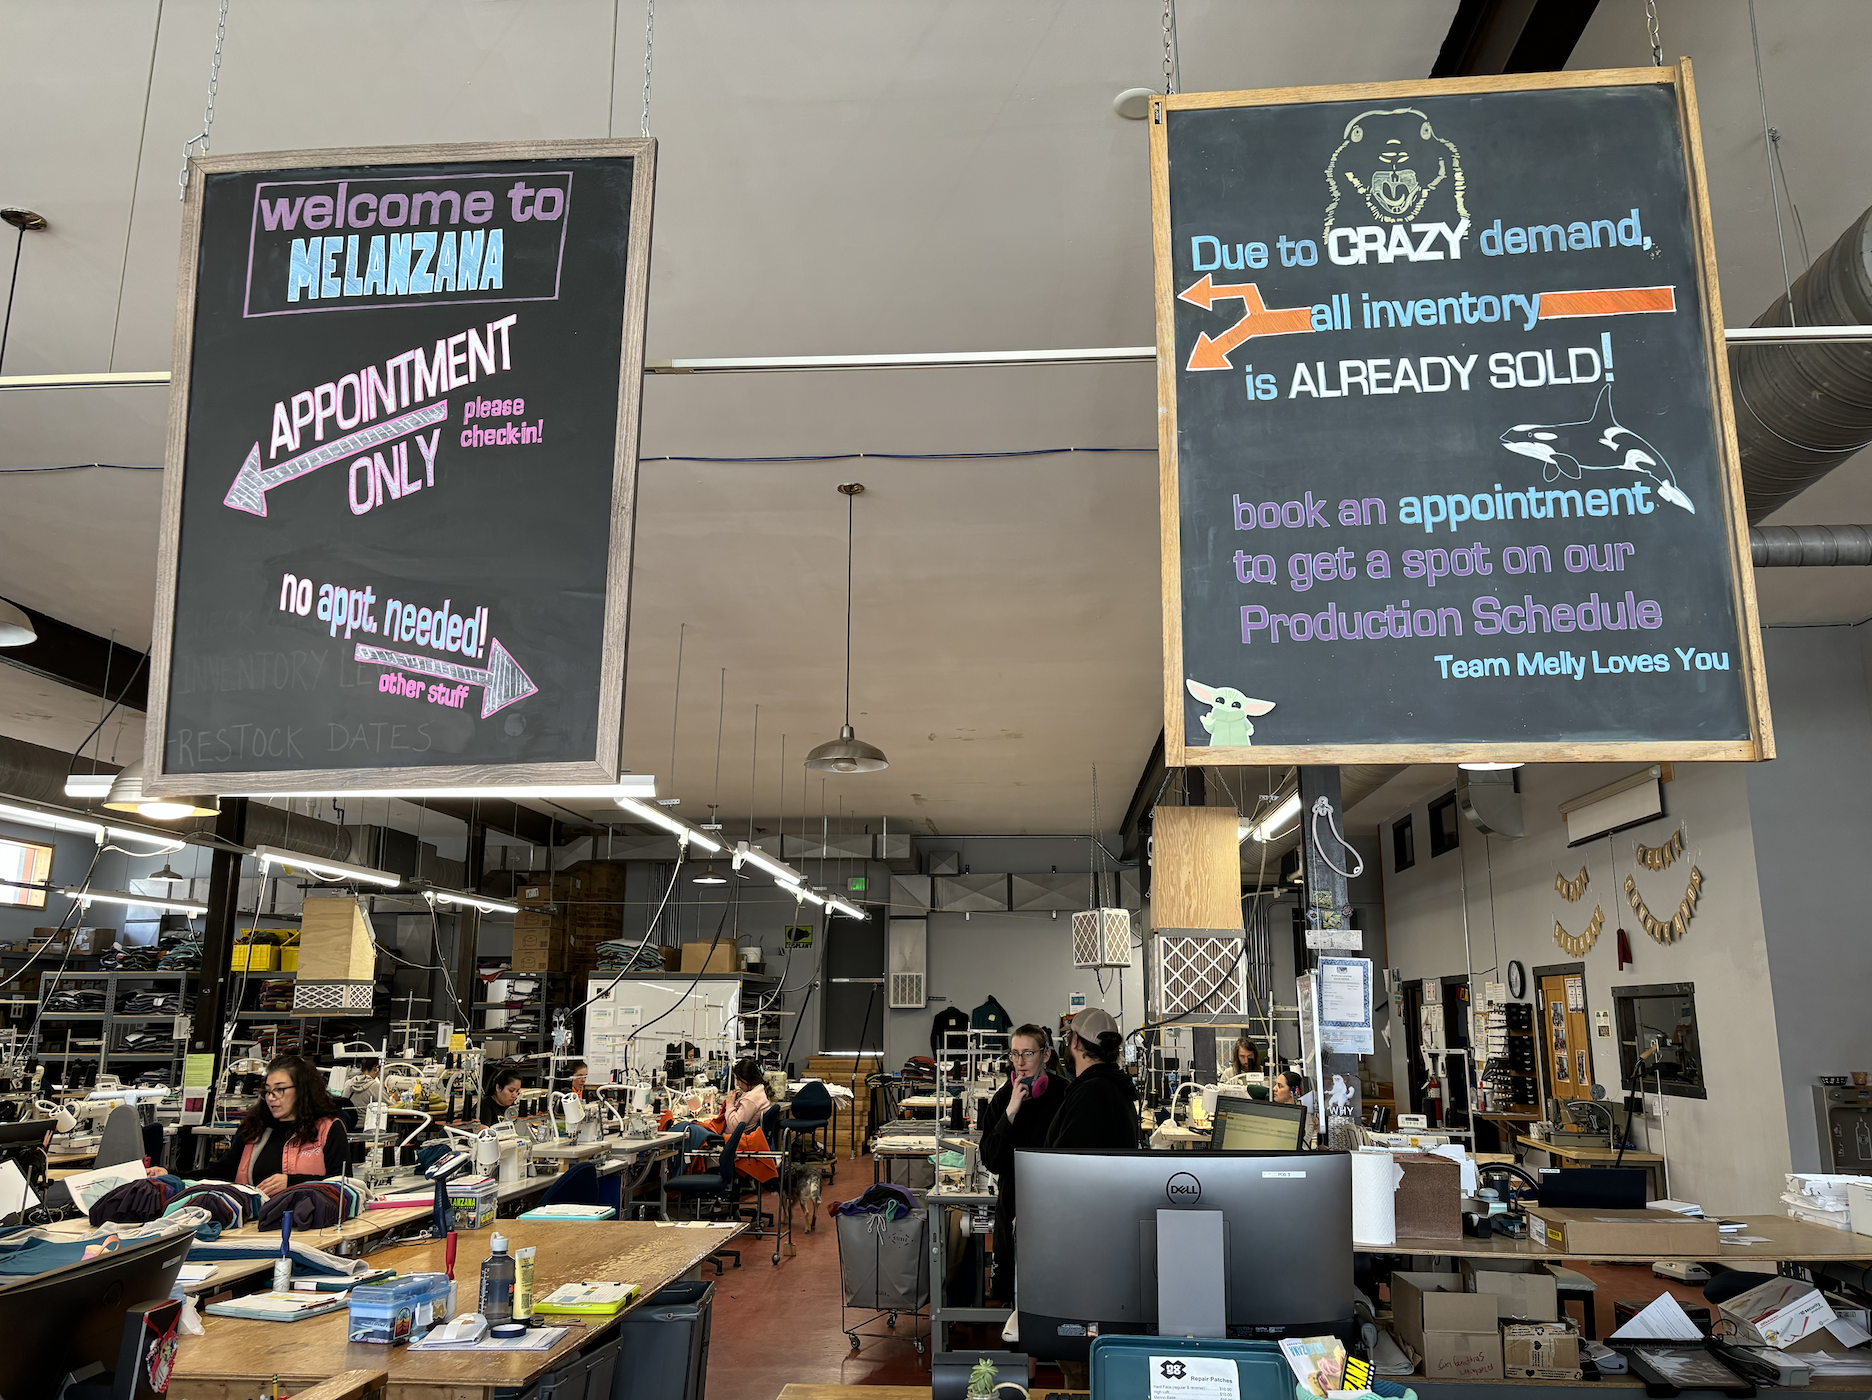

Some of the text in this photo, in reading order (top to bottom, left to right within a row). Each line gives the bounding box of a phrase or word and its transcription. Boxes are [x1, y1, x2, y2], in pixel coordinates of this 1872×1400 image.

[260, 181, 564, 231] welcome to
[1191, 208, 1652, 271] Due to CRAZY demand,
[287, 229, 504, 302] MELANZANA
[1310, 291, 1541, 332] all inventory
[269, 313, 518, 459] APPOINTMENT
[1245, 332, 1615, 400] is ALREADY SOLD!
[463, 396, 525, 425] please
[460, 419, 544, 447] check-in!
[348, 428, 441, 515] ONLY
[1232, 481, 1655, 533] book an appointment
[1233, 541, 1635, 592] to get a spot on our
[279, 572, 489, 659] no appt. needed!
[1240, 591, 1663, 644] Production Schedule
[1434, 647, 1730, 680] Team Melly Loves You
[378, 672, 470, 709] other stuff
[327, 720, 436, 752] DATES
[1637, 834, 1678, 864] FELIZ
[1556, 871, 1585, 896] HAPPY
[1555, 909, 1600, 952] BIRTHDAY
[1328, 1106, 1354, 1116] WHY
[1171, 1185, 1197, 1194] DELL
